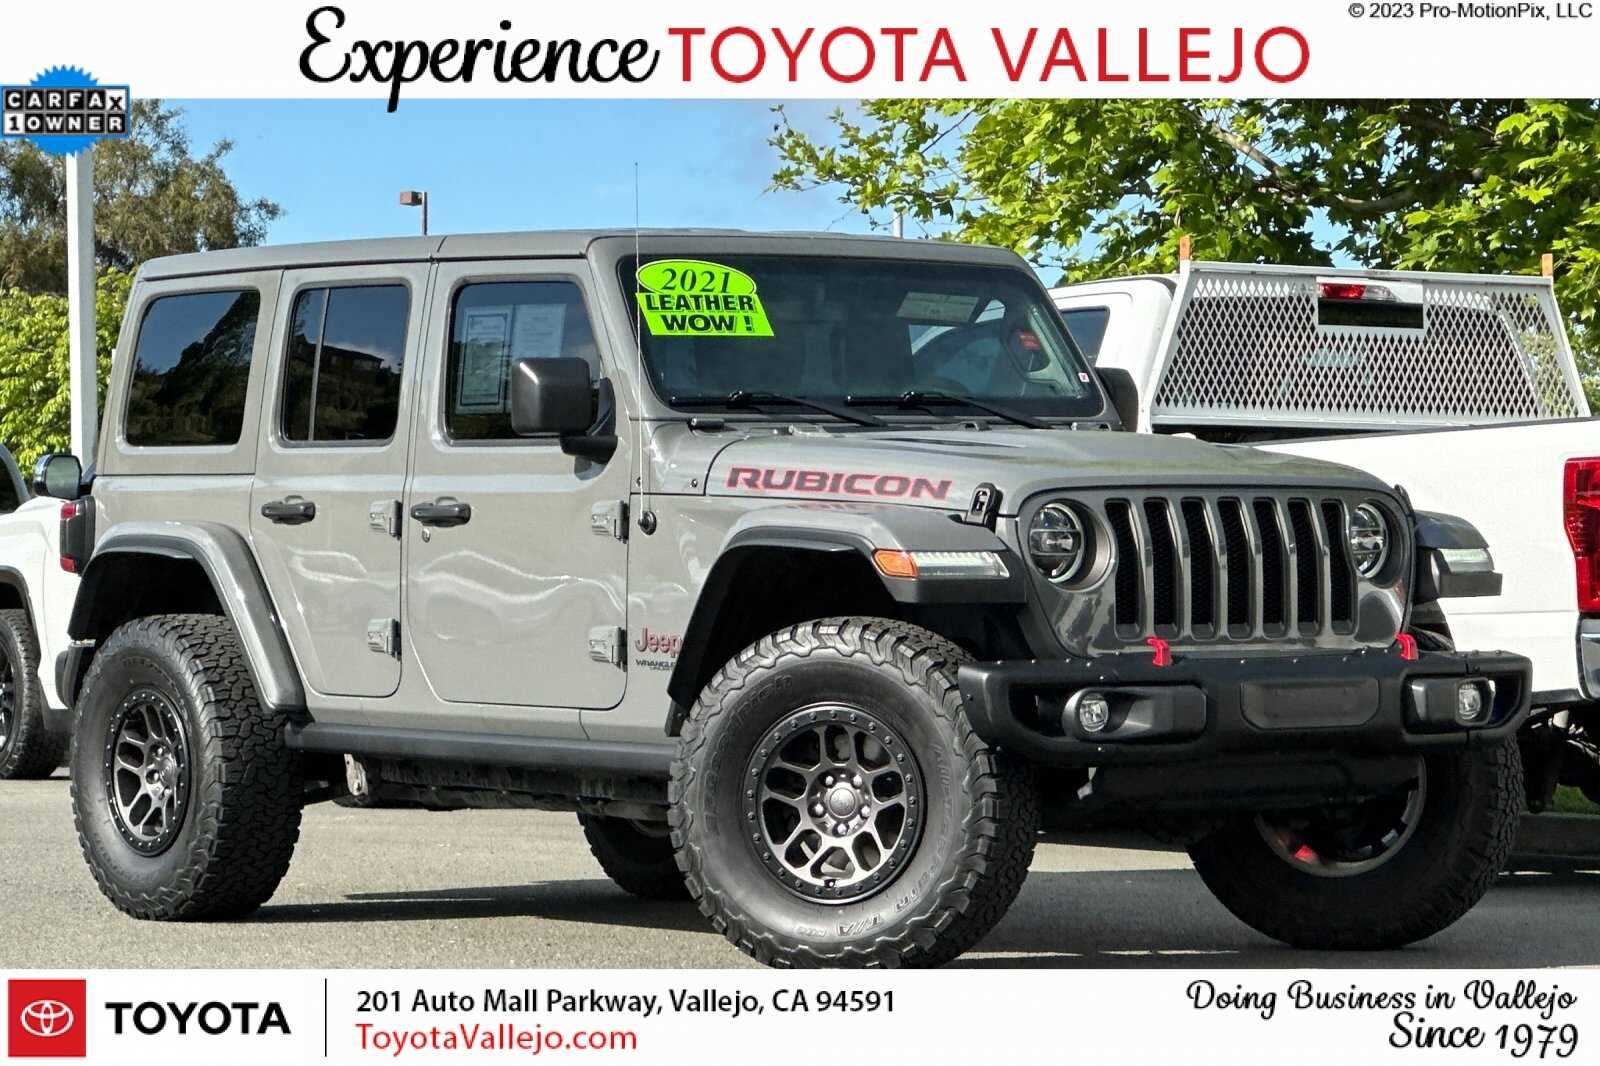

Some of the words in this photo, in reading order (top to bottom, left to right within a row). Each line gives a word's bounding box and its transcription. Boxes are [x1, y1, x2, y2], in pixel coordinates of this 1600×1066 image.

[661, 268, 730, 293] 2021
[645, 294, 755, 311] LEATHER
[726, 465, 953, 501] RUBICON
[635, 625, 682, 659] Jeep
